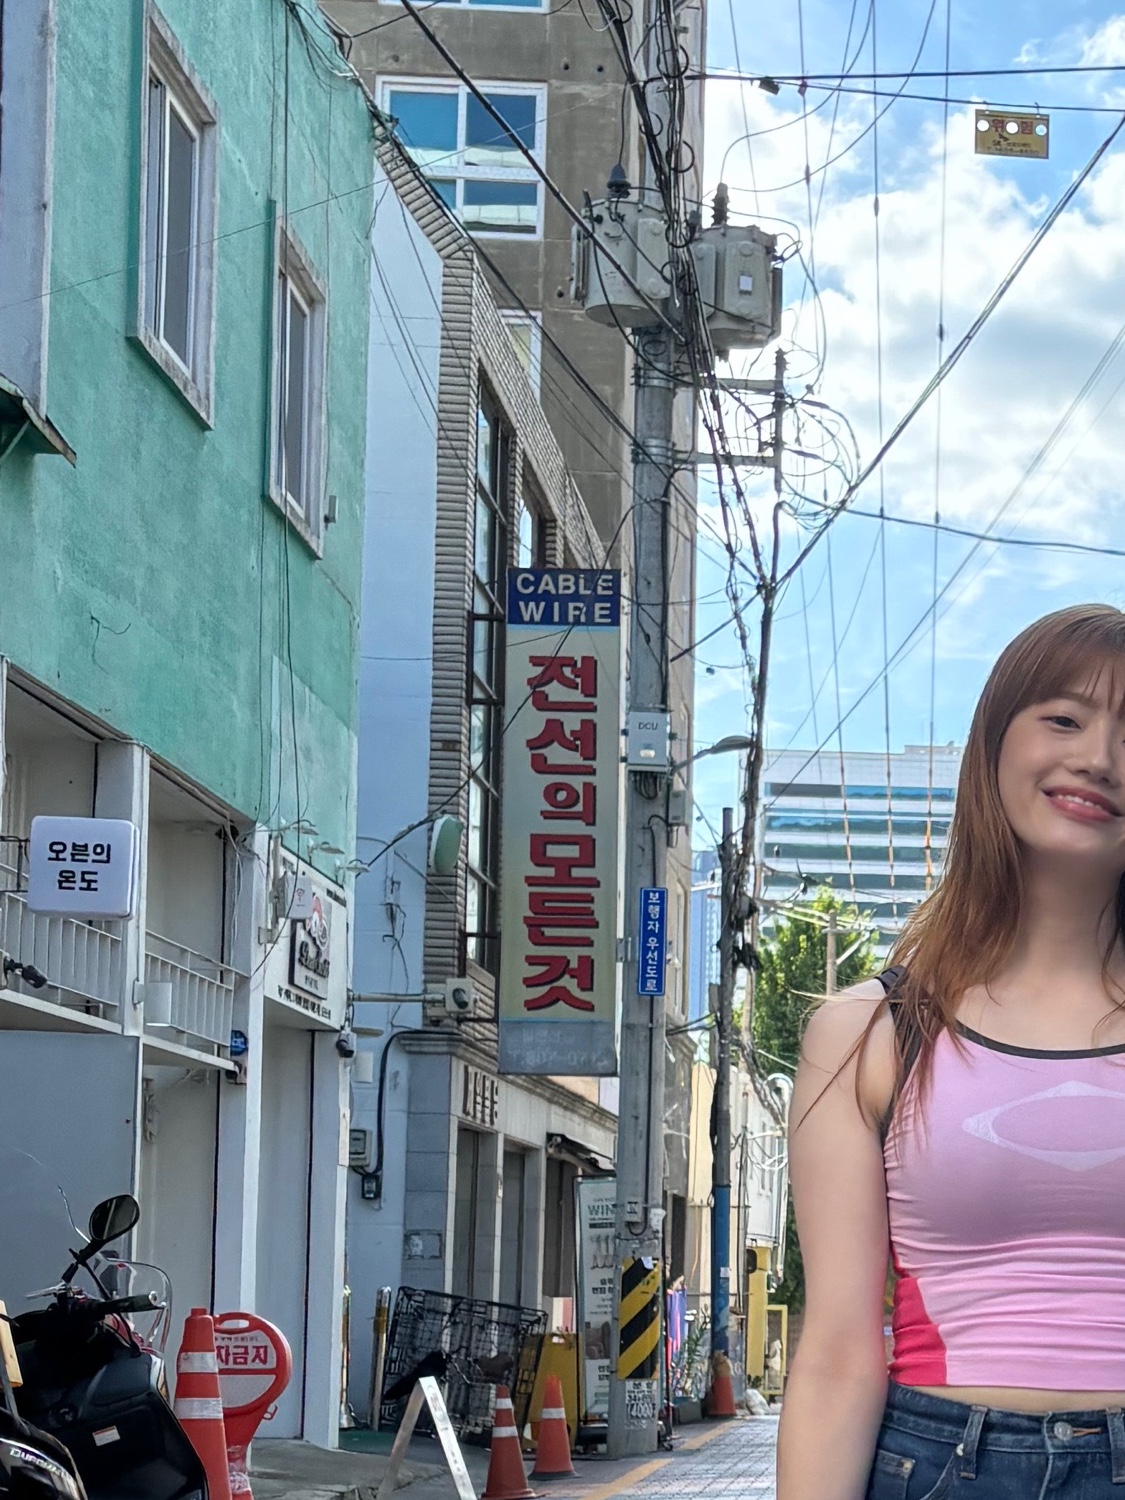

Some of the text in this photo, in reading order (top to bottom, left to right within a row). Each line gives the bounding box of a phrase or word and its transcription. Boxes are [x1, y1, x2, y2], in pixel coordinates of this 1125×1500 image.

[517, 573, 613, 595] CABLE
[519, 601, 612, 623] WIRE
[638, 722, 658, 730] DCU
[47, 841, 111, 864] 오븐의
[57, 869, 98, 892] 온도
[645, 892, 660, 991] 보행자 우선도로
